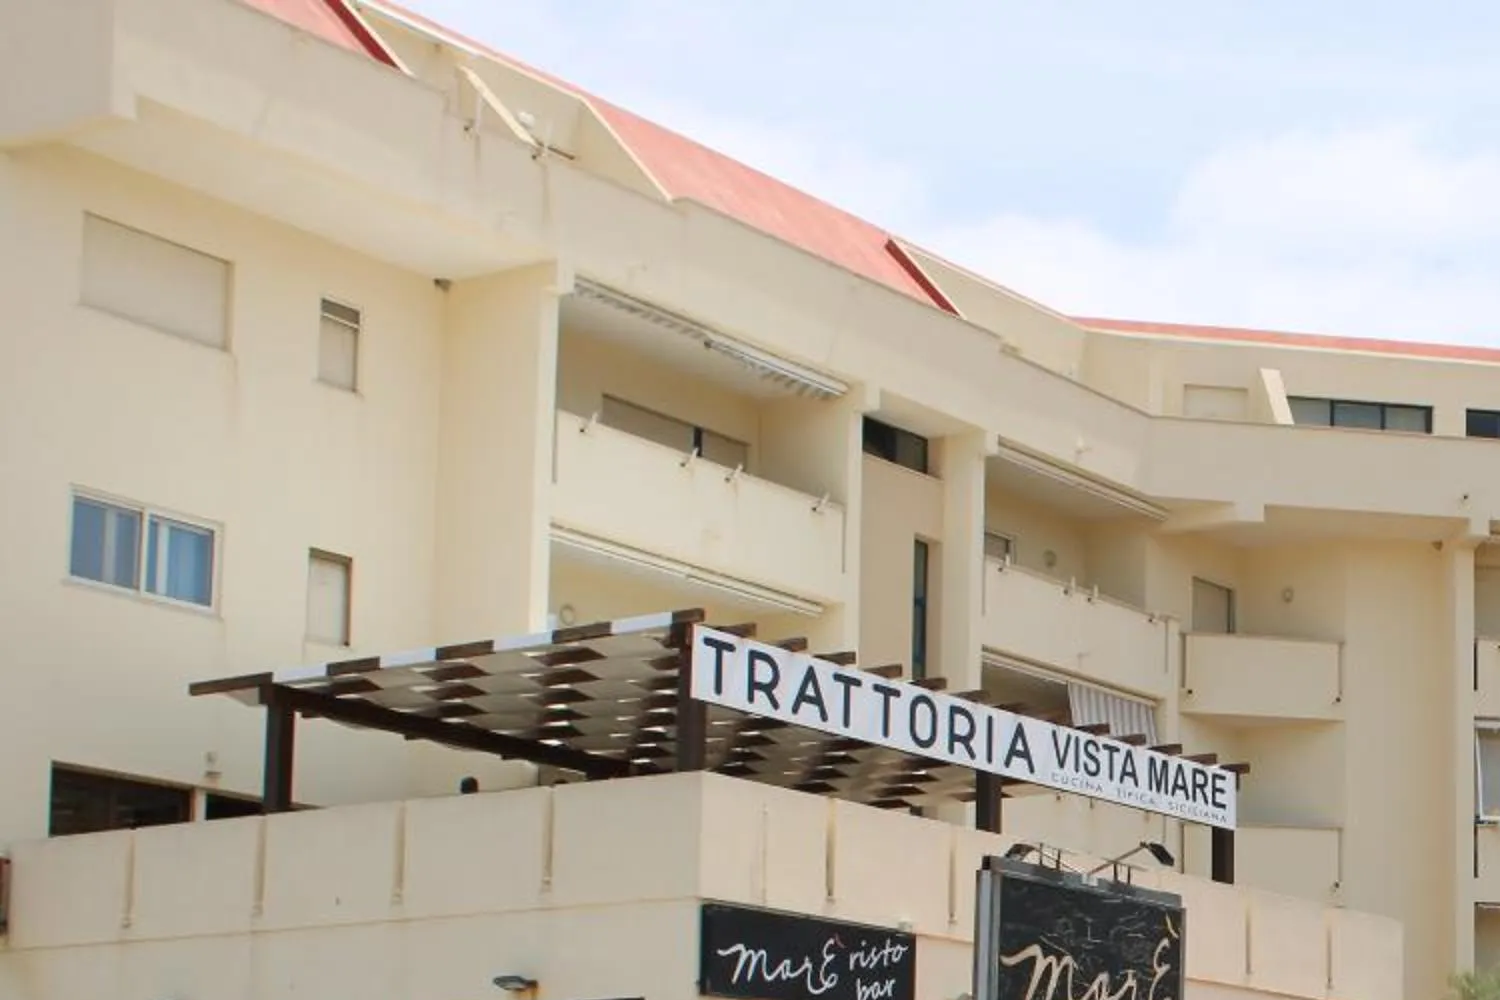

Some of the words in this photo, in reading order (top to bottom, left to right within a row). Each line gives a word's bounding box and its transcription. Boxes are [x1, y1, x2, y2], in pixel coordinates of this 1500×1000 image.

[702, 636, 1036, 774] TRATTORIA
[1051, 729, 1139, 788] VISTA
[1149, 756, 1227, 810] MARE
[1051, 772, 1104, 794] CUCINA
[849, 938, 909, 971] risto
